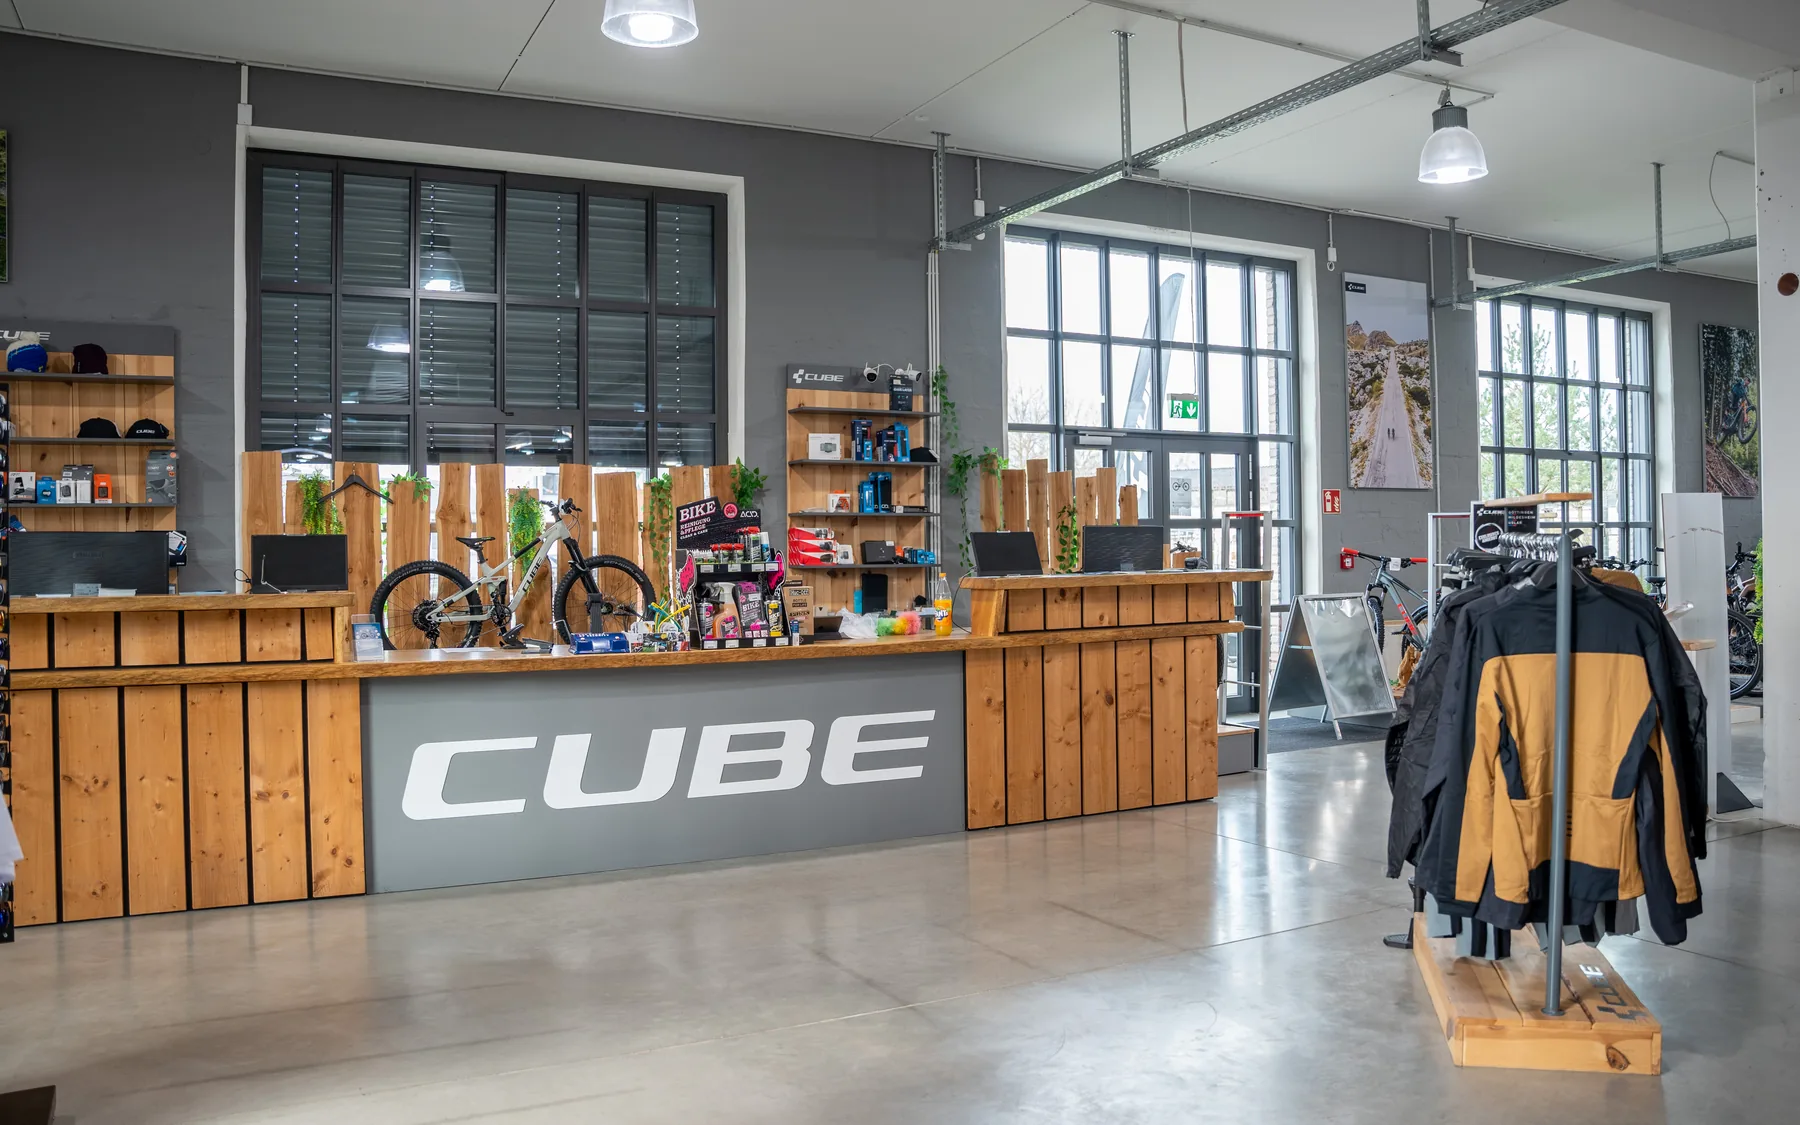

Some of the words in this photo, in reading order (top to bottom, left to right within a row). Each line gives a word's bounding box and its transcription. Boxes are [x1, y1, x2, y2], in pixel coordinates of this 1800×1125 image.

[0, 330, 51, 340] UE
[805, 373, 844, 383] CUBE
[680, 501, 716, 522] BIKE
[680, 517, 711, 530] REINIGUNG
[522, 558, 544, 593] CUBE
[742, 601, 760, 612] BIKE
[402, 709, 935, 820] CUBE
